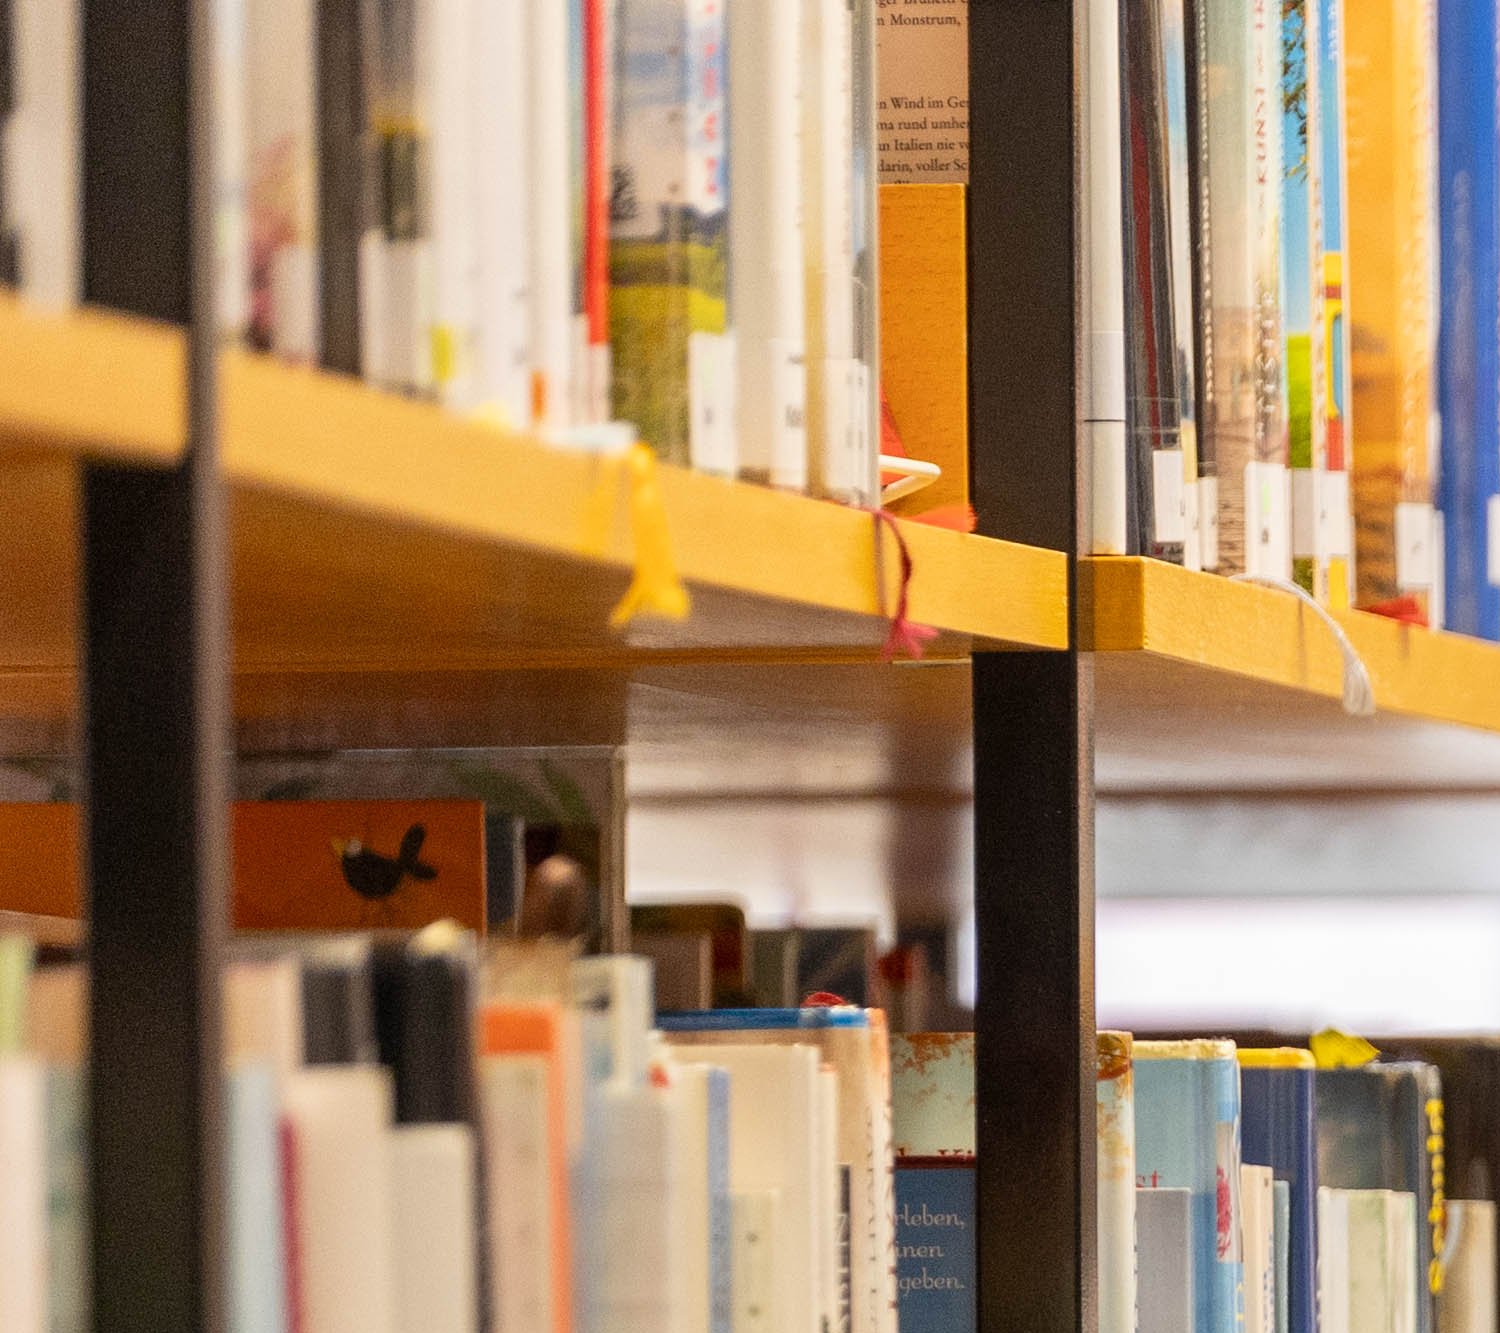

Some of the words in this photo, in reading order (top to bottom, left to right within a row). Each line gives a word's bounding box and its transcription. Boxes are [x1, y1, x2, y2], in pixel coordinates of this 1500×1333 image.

[890, 13, 961, 27] Monstrum,
[890, 97, 924, 109] Wind
[928, 97, 944, 109] im
[898, 117, 927, 130] rund
[894, 138, 933, 151] Italien
[936, 138, 955, 150] nie
[915, 158, 951, 172] voller
